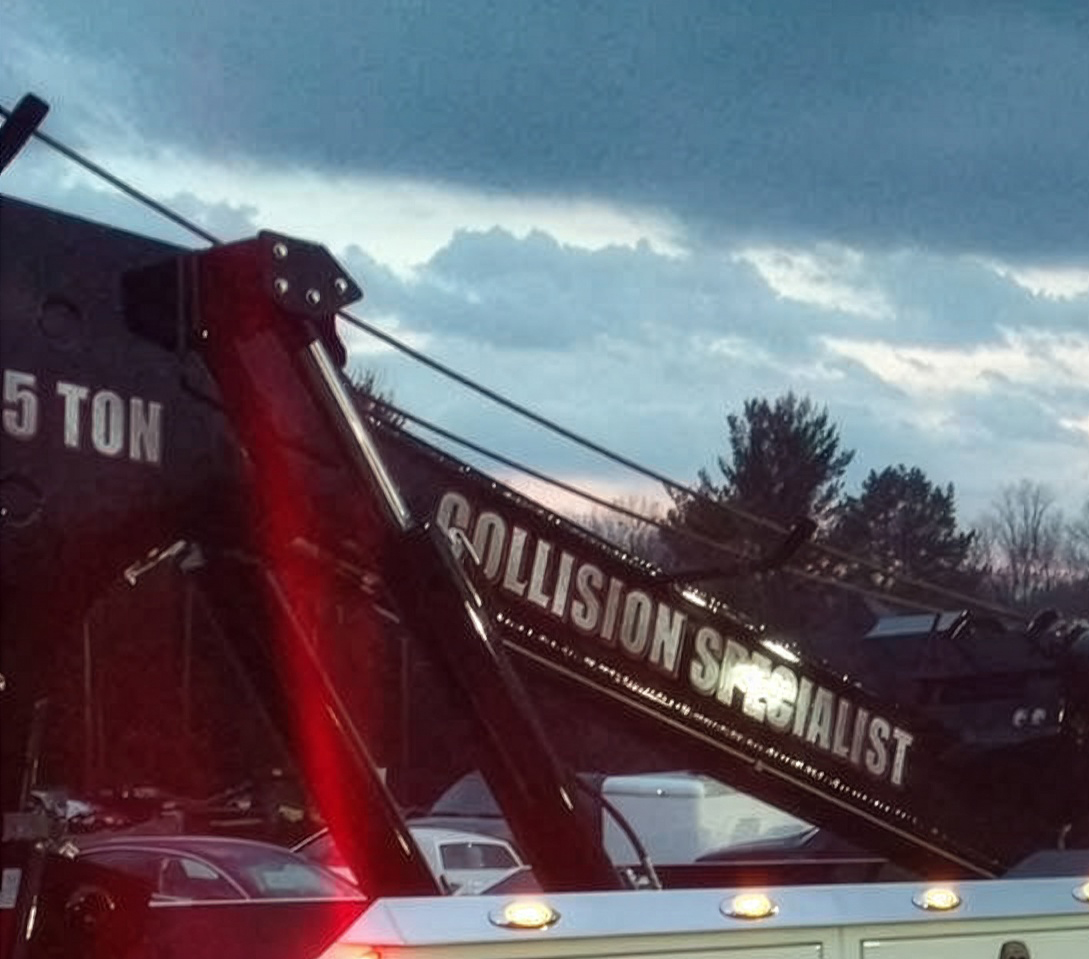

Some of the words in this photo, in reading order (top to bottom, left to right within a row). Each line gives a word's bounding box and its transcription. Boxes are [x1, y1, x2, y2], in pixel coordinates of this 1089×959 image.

[3, 369, 38, 437] 5
[56, 380, 161, 463] TON
[436, 491, 688, 679] COLLISION
[690, 626, 914, 787] SPECIALIST
